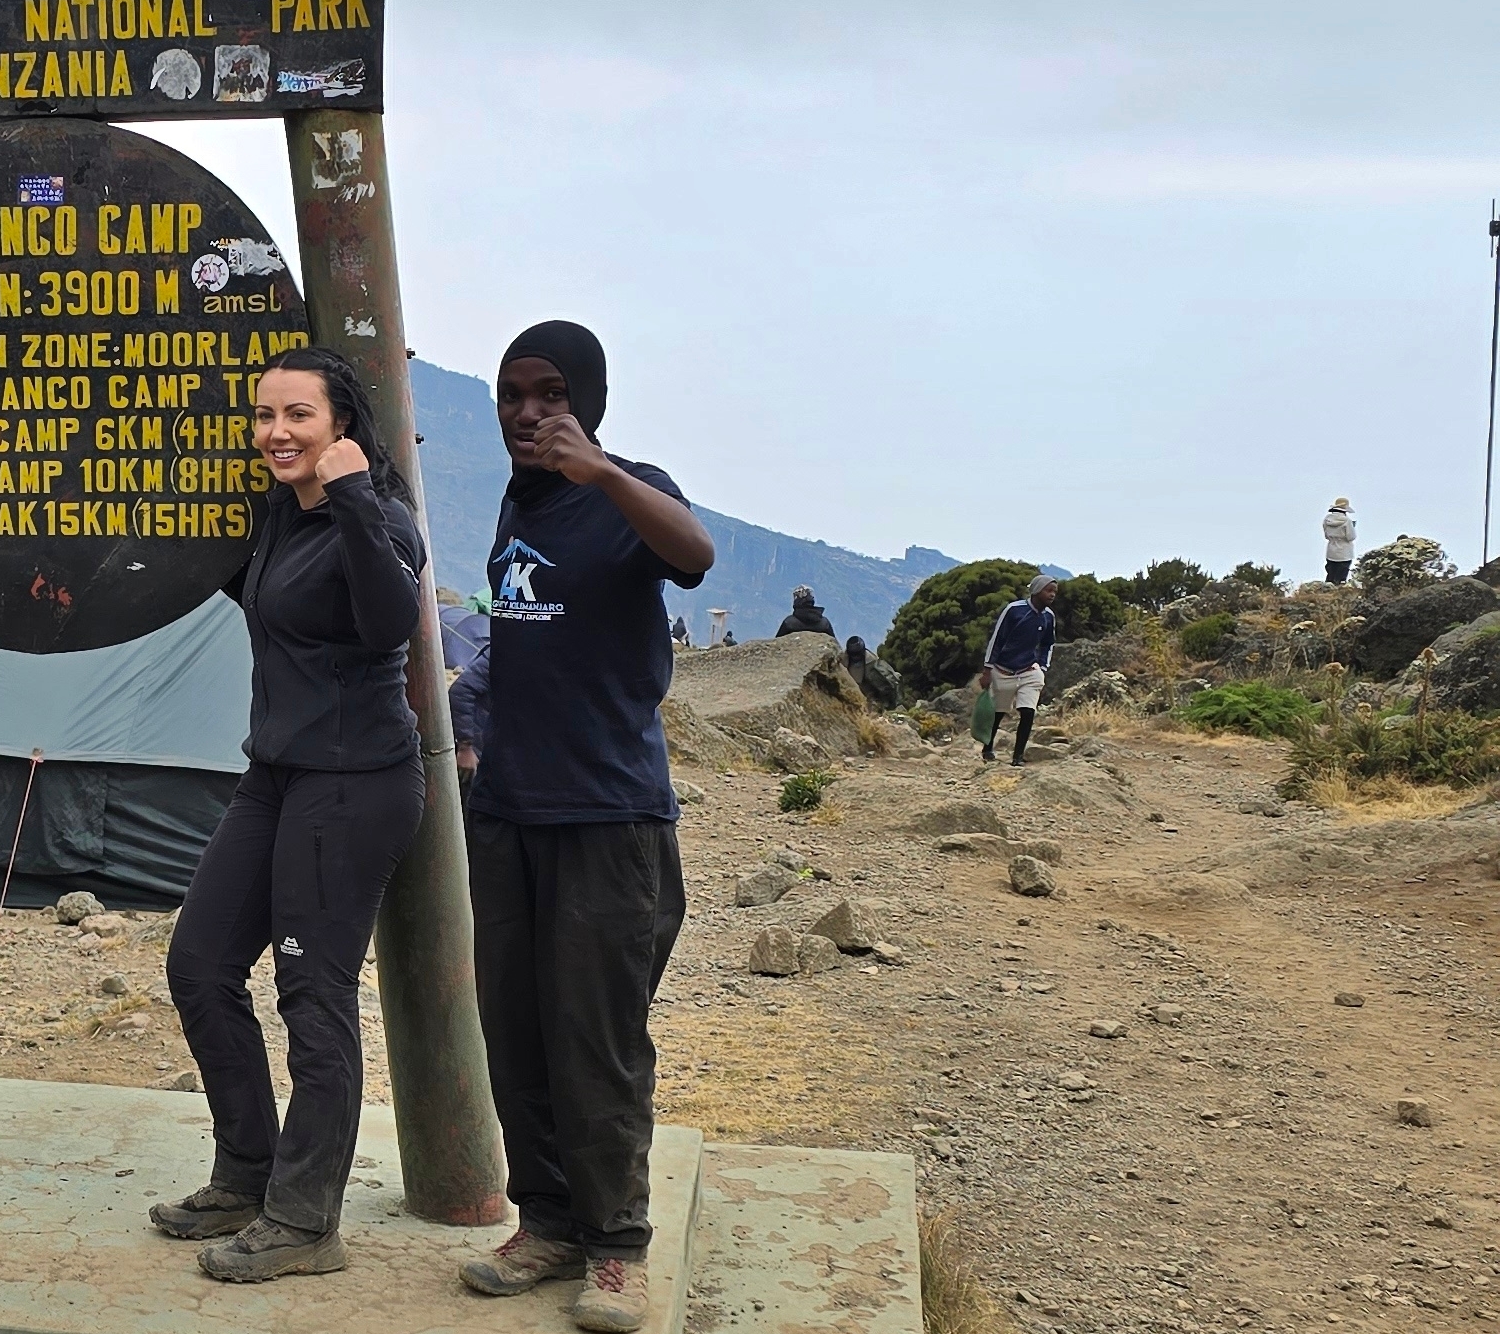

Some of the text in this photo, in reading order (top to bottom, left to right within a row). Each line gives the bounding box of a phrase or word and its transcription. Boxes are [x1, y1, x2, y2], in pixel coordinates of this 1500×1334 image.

[99, 204, 202, 255] CAMP
[39, 270, 139, 316] 3900
[156, 269, 180, 315] M
[203, 283, 282, 314] amsl
[108, 373, 201, 409] CAMP
[95, 415, 163, 451] 6KM
[172, 410, 264, 455] (4HR
[79, 457, 164, 493] 10KM
